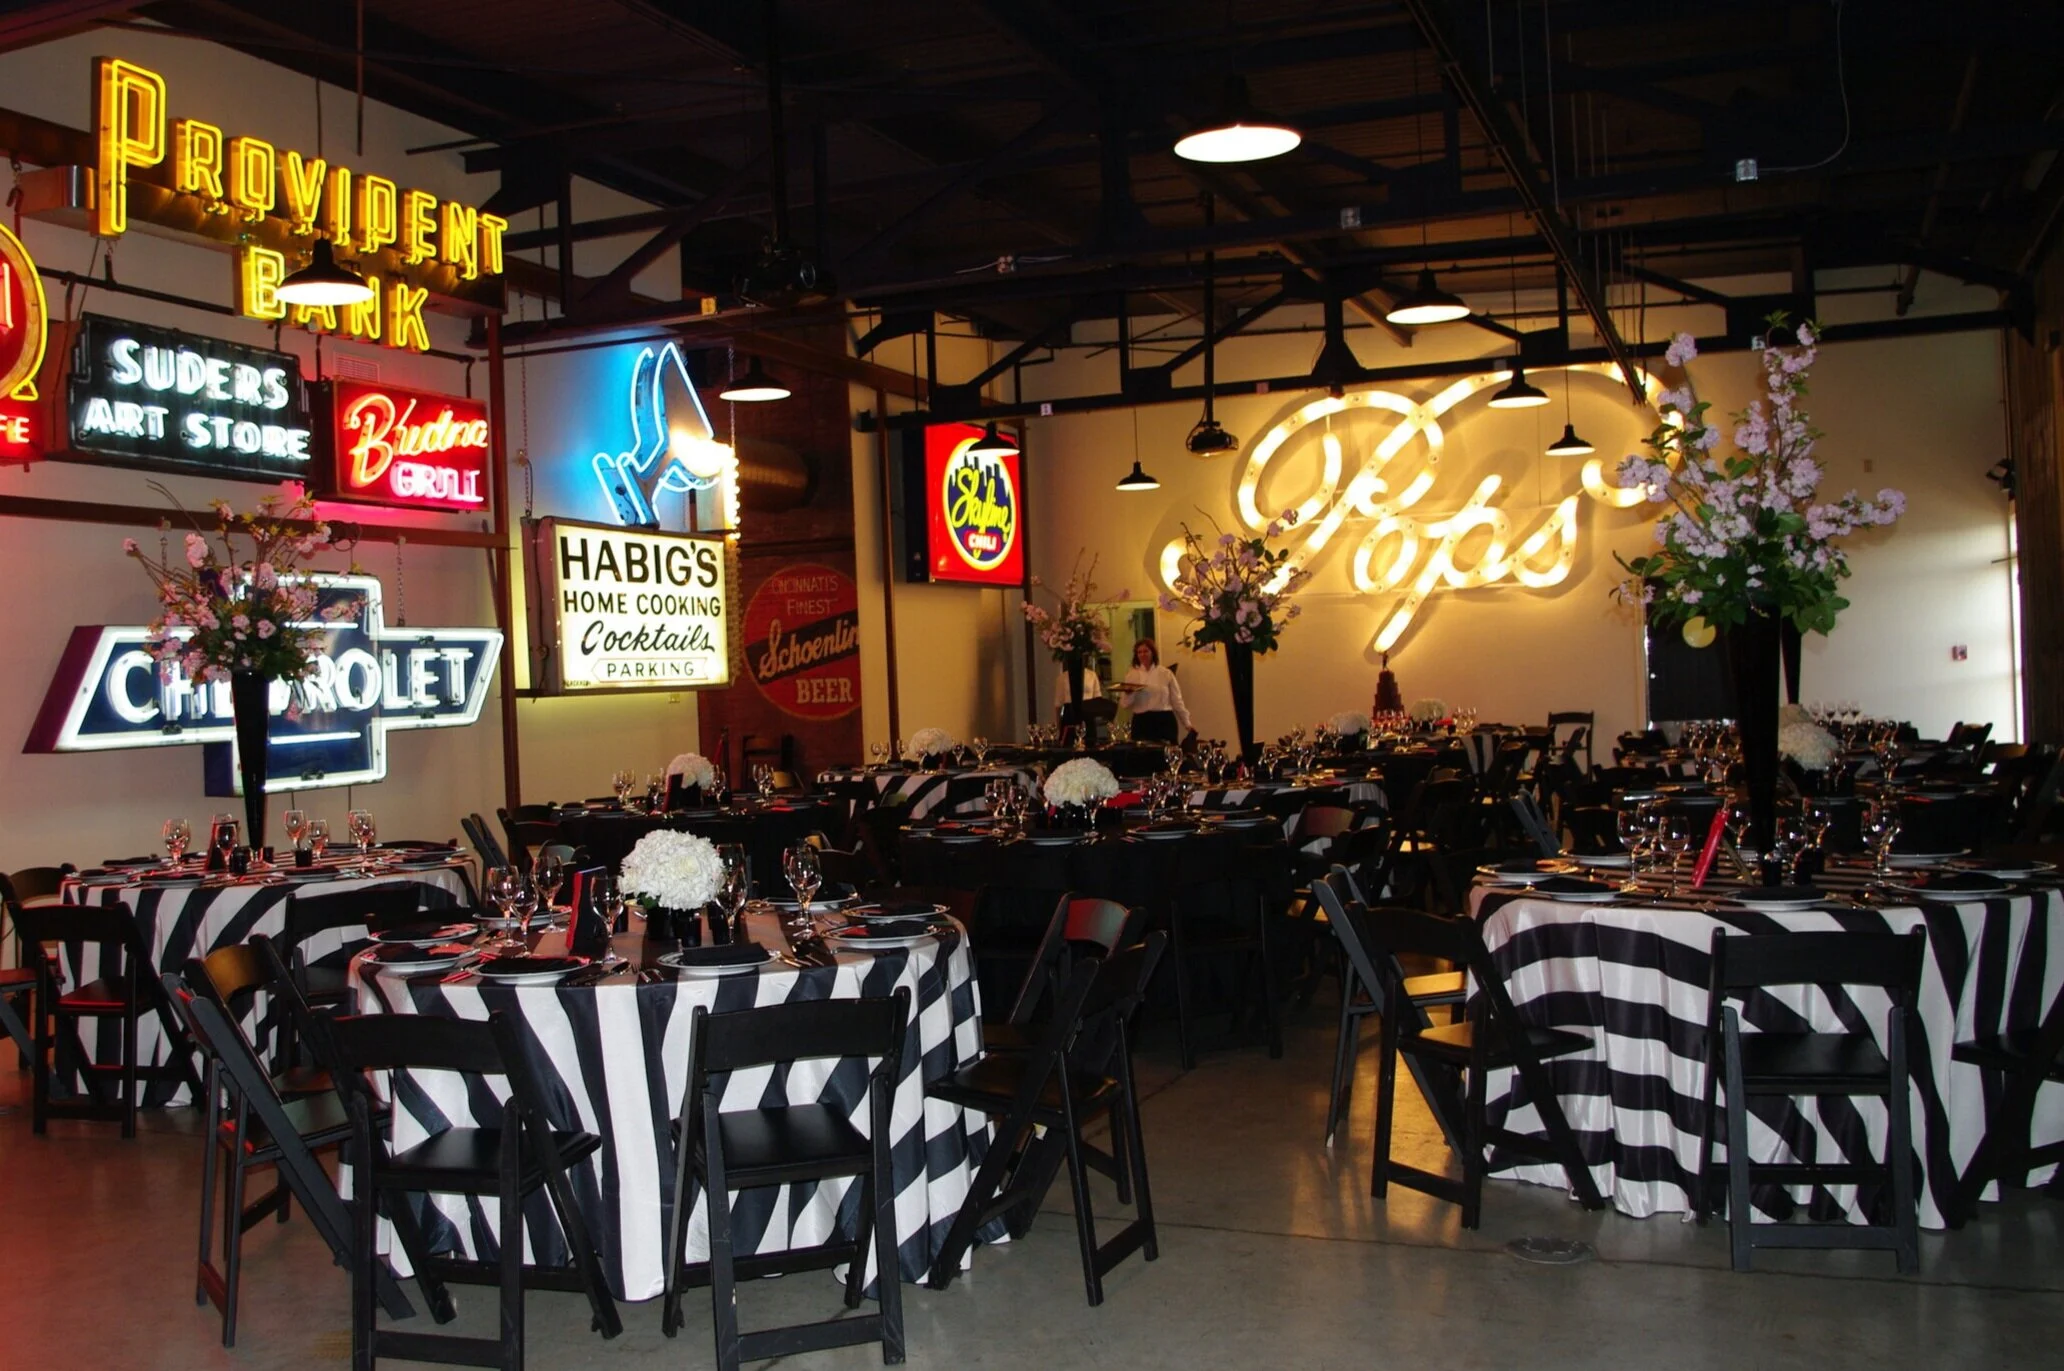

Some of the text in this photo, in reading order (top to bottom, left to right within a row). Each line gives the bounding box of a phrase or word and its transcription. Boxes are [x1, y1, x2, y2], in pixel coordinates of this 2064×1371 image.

[94, 58, 508, 281] PROVIDENT
[110, 338, 290, 410] SUDERS
[83, 398, 312, 460] ART STORE
[390, 461, 485, 503] GRILL
[951, 467, 1011, 560] Skyline
[1160, 366, 1680, 652] Pops
[560, 536, 719, 588] HABIG'S
[968, 534, 997, 551] CHILI
[564, 590, 721, 617] HOME COOKING
[787, 598, 832, 616] FINEST
[581, 620, 715, 656] Cocktails
[607, 661, 694, 677] PARKING
[796, 678, 853, 704] BEER
